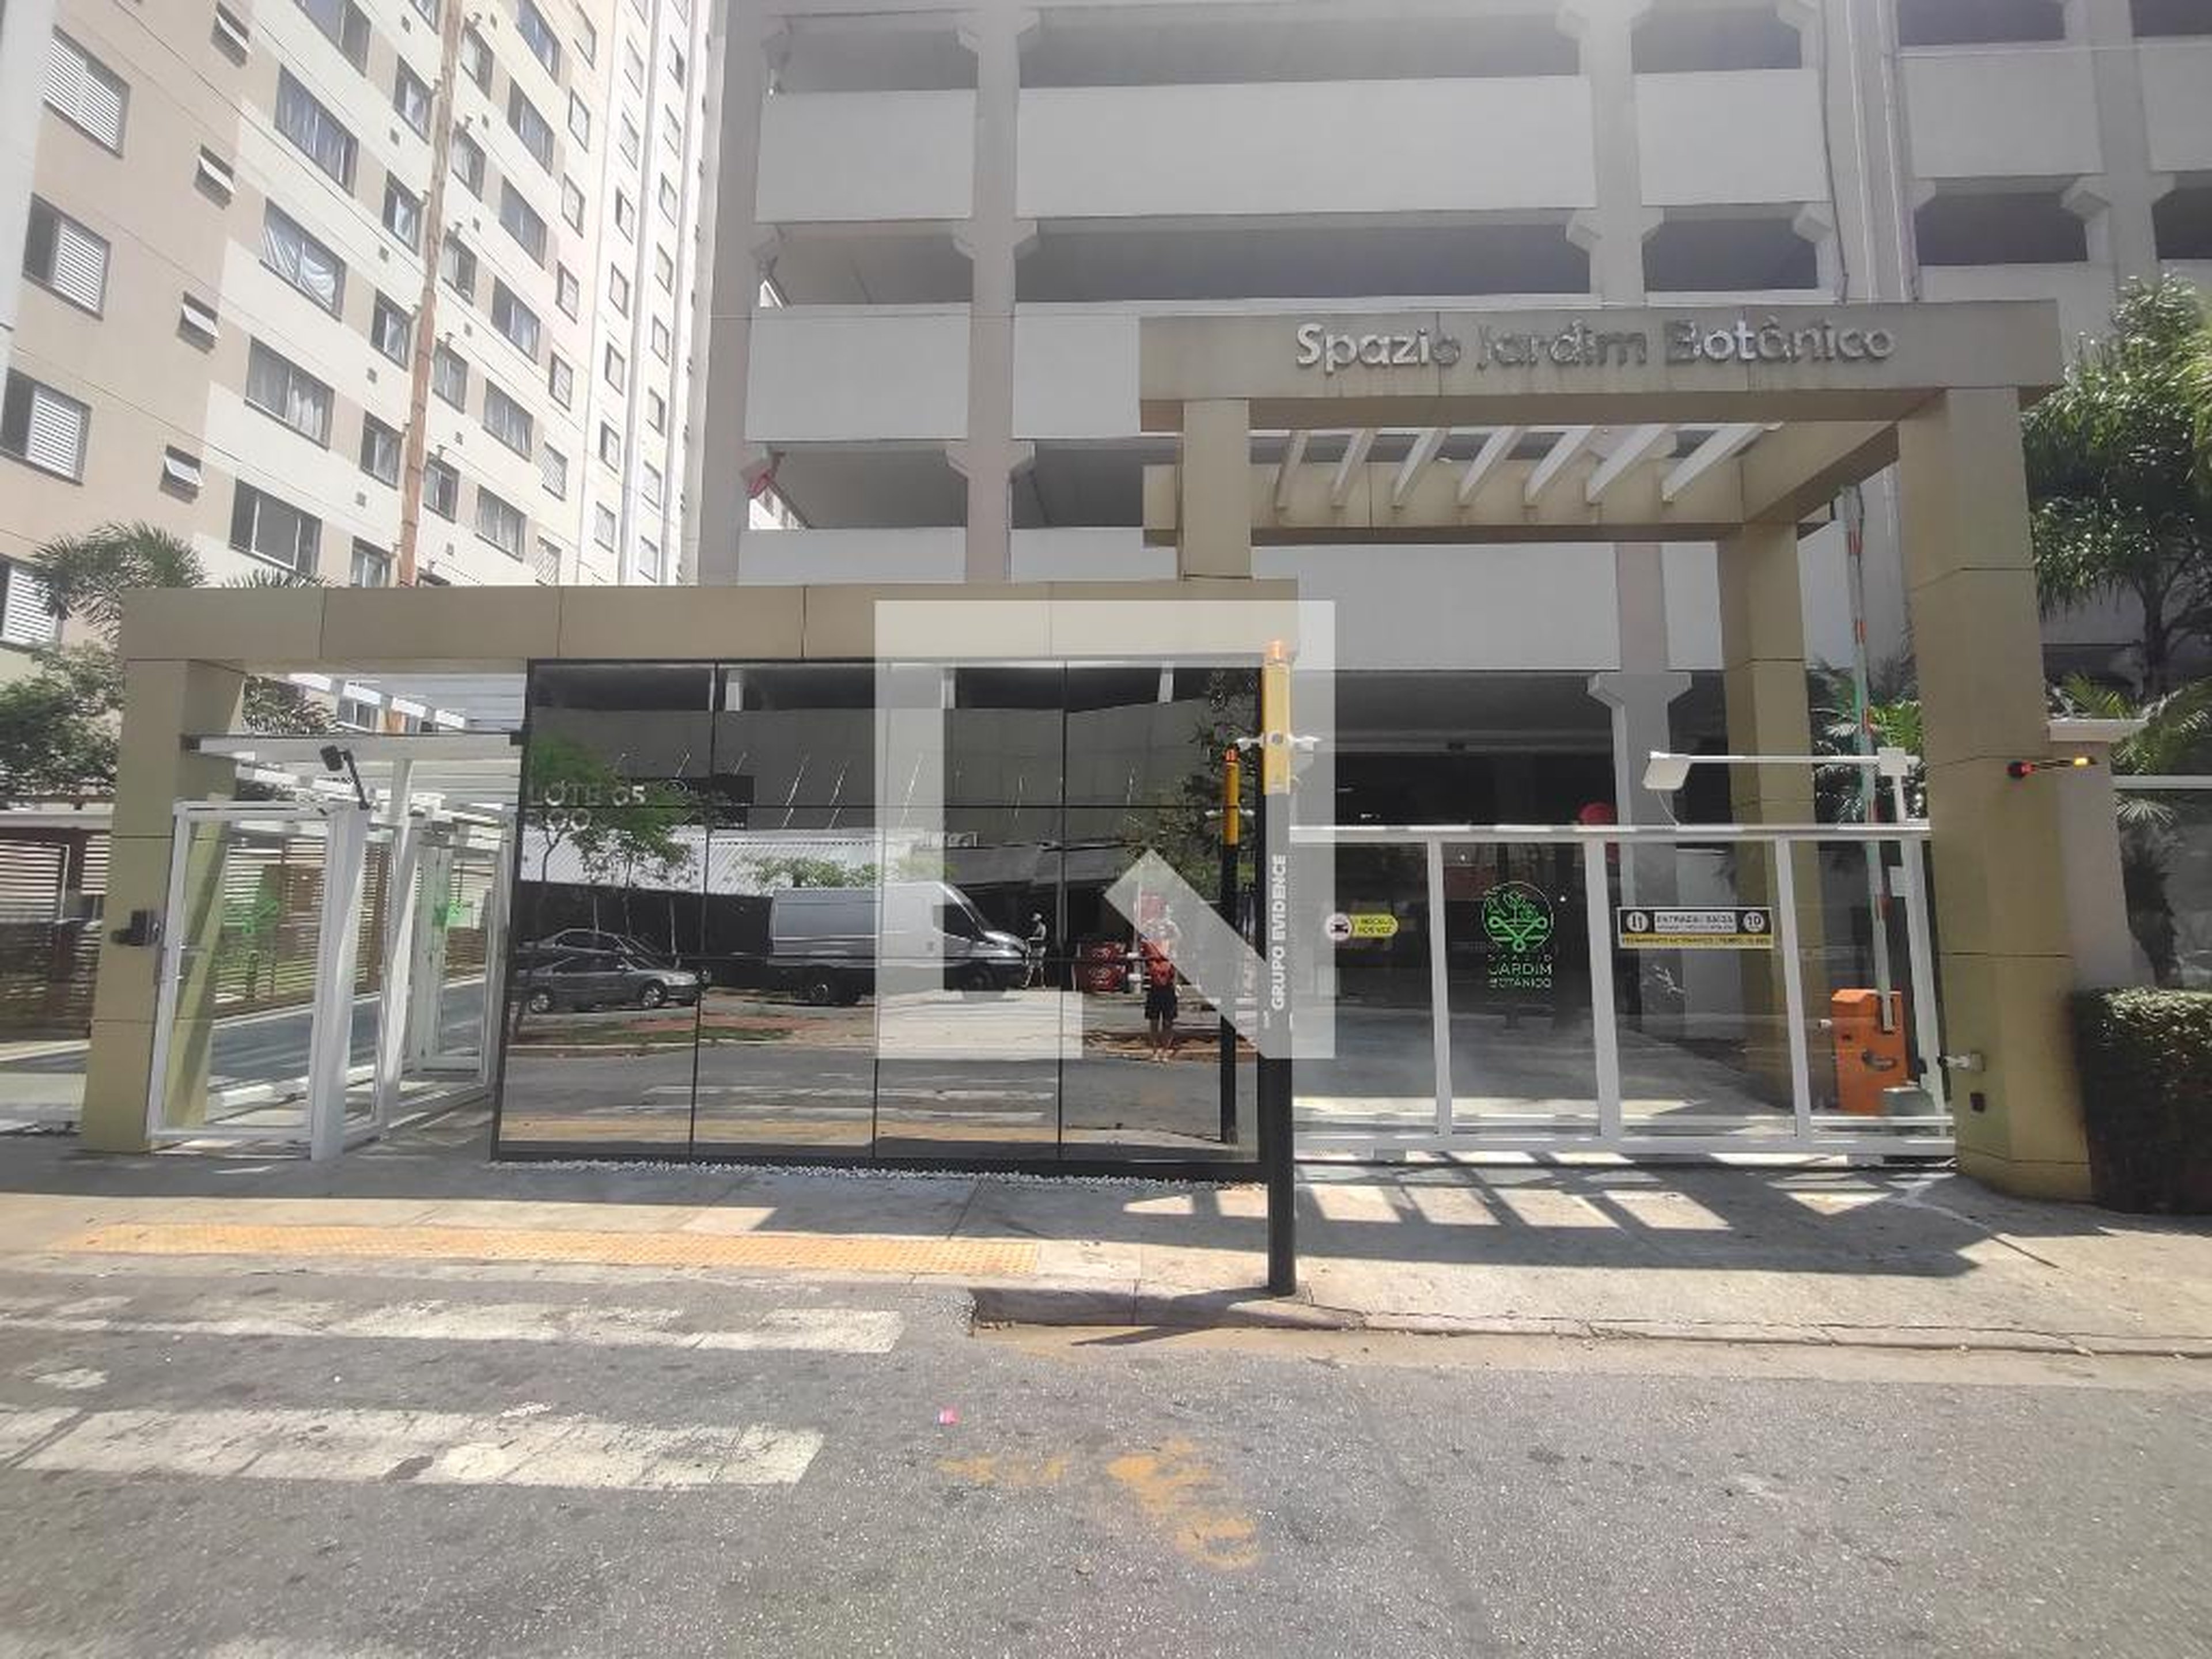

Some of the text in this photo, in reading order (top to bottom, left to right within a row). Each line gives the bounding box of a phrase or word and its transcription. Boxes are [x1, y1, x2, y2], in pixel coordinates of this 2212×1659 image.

[1296, 315, 1893, 374] Spazio Jardim Botânico
[1271, 854, 1286, 1010] GRUPO EVIDENCE
